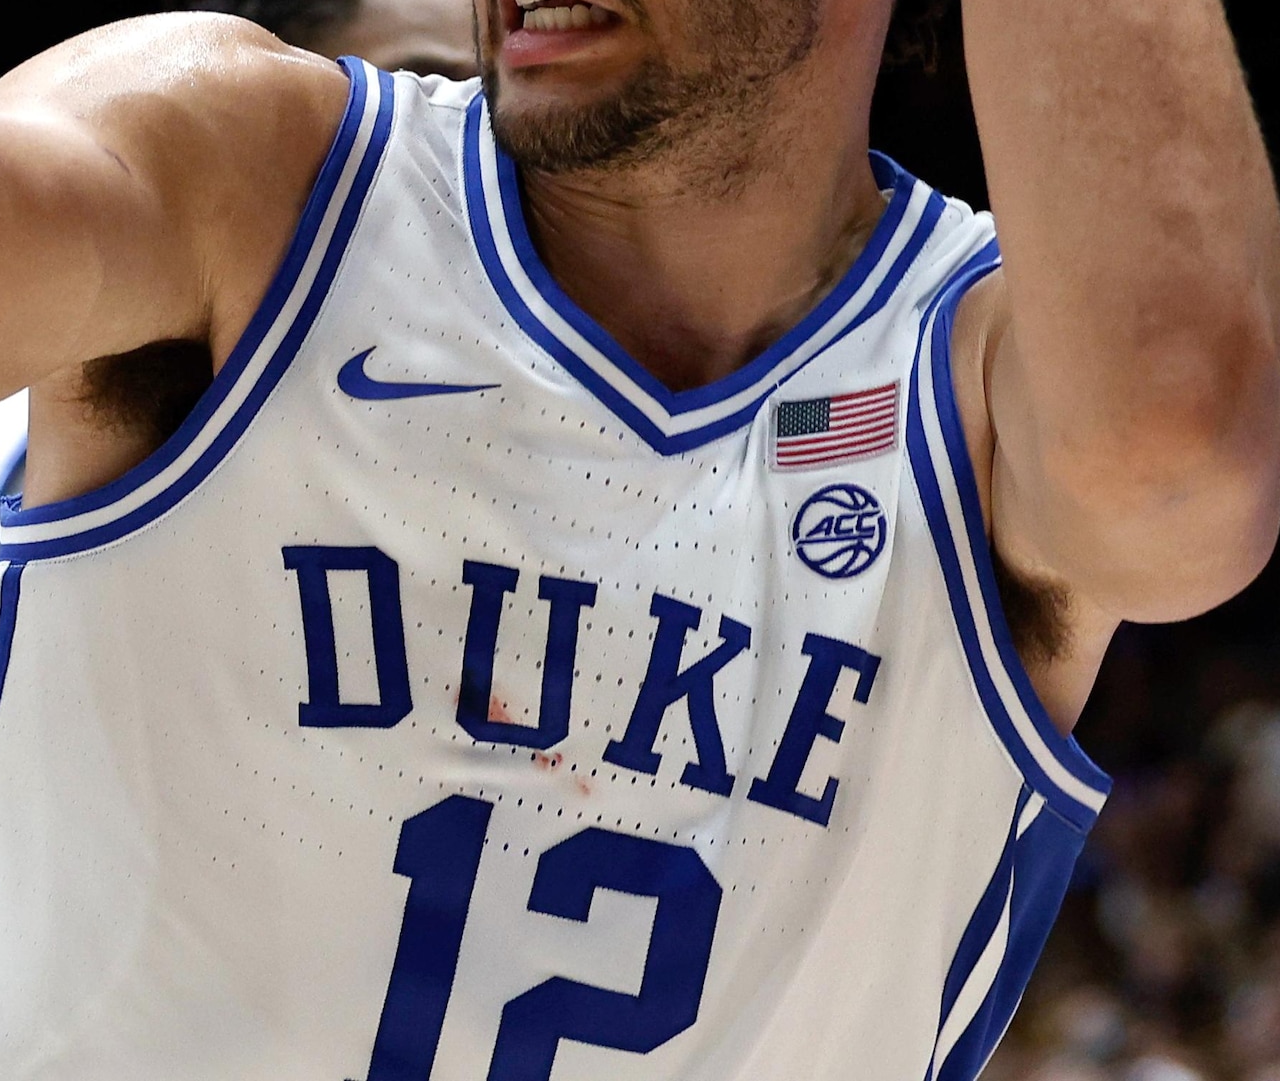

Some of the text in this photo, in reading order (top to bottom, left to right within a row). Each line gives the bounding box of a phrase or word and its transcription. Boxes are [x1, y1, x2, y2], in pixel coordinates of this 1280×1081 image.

[805, 510, 880, 539] ACC
[282, 546, 881, 827] DUKE
[344, 794, 723, 1081] 12
